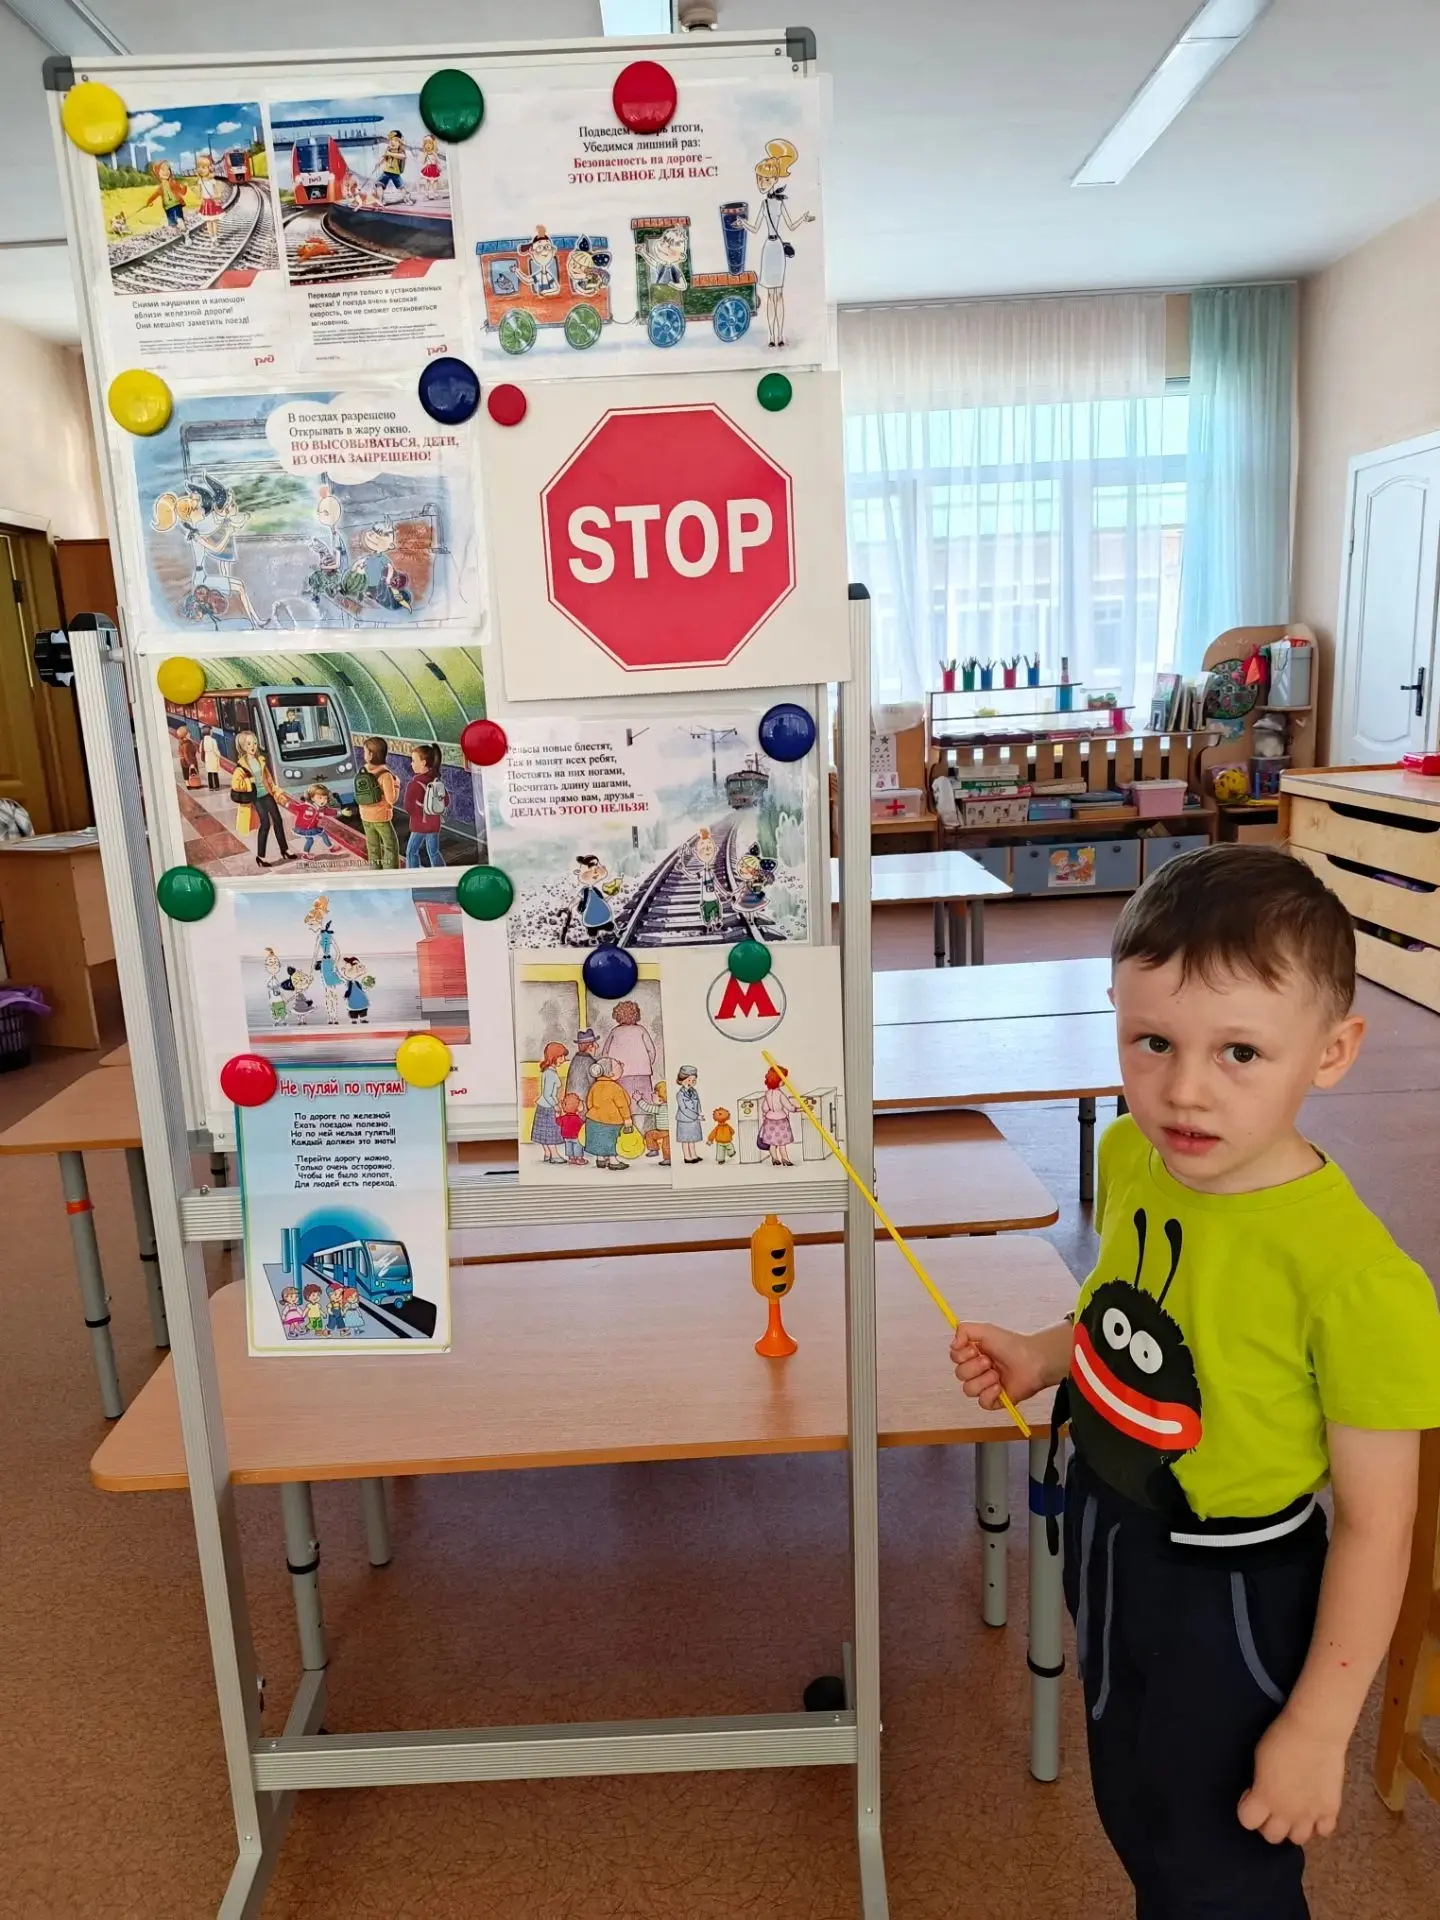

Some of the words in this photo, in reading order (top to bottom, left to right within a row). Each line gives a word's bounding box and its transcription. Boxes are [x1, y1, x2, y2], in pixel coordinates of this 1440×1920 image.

[671, 123, 704, 133] итоги,
[583, 142, 633, 153] Убедимся
[636, 138, 678, 150] лишний
[681, 139, 701, 150] раз:
[573, 157, 647, 169] Безопасность
[650, 156, 664, 164] на
[667, 154, 703, 166] дороге
[568, 173, 594, 184] ЭТО
[597, 169, 656, 183] ГЛАВНОЕ
[658, 168, 684, 181] ДЛЯ
[688, 166, 719, 178] НАС!
[390, 285, 442, 295] установленных
[132, 300, 159, 309] Сними
[161, 299, 200, 308] наушники
[209, 296, 245, 304] капюшон
[309, 301, 334, 309] местах!
[389, 296, 417, 304] высокая
[391, 304, 437, 313] остановиться
[134, 311, 162, 319] вблизи
[164, 309, 202, 318] железной
[204, 307, 234, 316] дороги!
[135, 322, 151, 330] Они
[153, 321, 185, 329] мешают
[187, 319, 223, 327] заметить
[225, 316, 250, 325] поезд!
[288, 413, 296, 423] В
[298, 413, 338, 423] поездах
[341, 412, 396, 423] разрешено
[289, 427, 344, 438] Открывать
[355, 427, 381, 437] жару
[291, 441, 309, 451] НО
[312, 437, 420, 450] ВЫСОВЫВАТЬСЯ,
[423, 436, 459, 448] ДЕТИ,
[292, 455, 308, 465] ИЗ
[310, 453, 346, 465] ОКНА
[349, 451, 431, 464] ЗАПРЕЩЕНО!
[568, 498, 773, 584] STOP
[543, 745, 572, 753] новые
[575, 742, 613, 752] блестят,
[526, 758, 533, 766] и
[535, 757, 563, 766] манят
[566, 756, 587, 765] всех
[589, 754, 617, 765] ребят,
[508, 770, 552, 780] Постоять
[554, 770, 565, 778] на
[588, 768, 625, 777] ногами,
[508, 783, 559, 792] Посчитать
[560, 781, 591, 791] длину
[592, 780, 631, 789] шагами,
[509, 796, 546, 805] Скажем
[549, 795, 579, 805] прямо
[581, 794, 601, 802] вам,
[603, 792, 635, 803] друзья
[510, 806, 557, 818] ДЕЛАТЬ
[560, 805, 598, 816] ЭТОГО
[601, 802, 649, 813] НЕЛЬЗЯ!
[280, 1079, 297, 1094] Не
[302, 1079, 339, 1099] гуляй
[344, 1083, 360, 1094] по
[365, 1078, 406, 1098] путям!
[309, 1113, 337, 1122] дороге
[353, 1112, 391, 1120] железной
[318, 1129, 333, 1137] ней
[365, 1128, 396, 1139] гулять!!!
[291, 1138, 323, 1147] Каждый
[326, 1138, 355, 1146] должен
[296, 1155, 331, 1164] Перейти
[334, 1156, 361, 1164] дорогу
[338, 1171, 358, 1179] было
[294, 1181, 310, 1189] Для
[313, 1180, 340, 1188] людей
